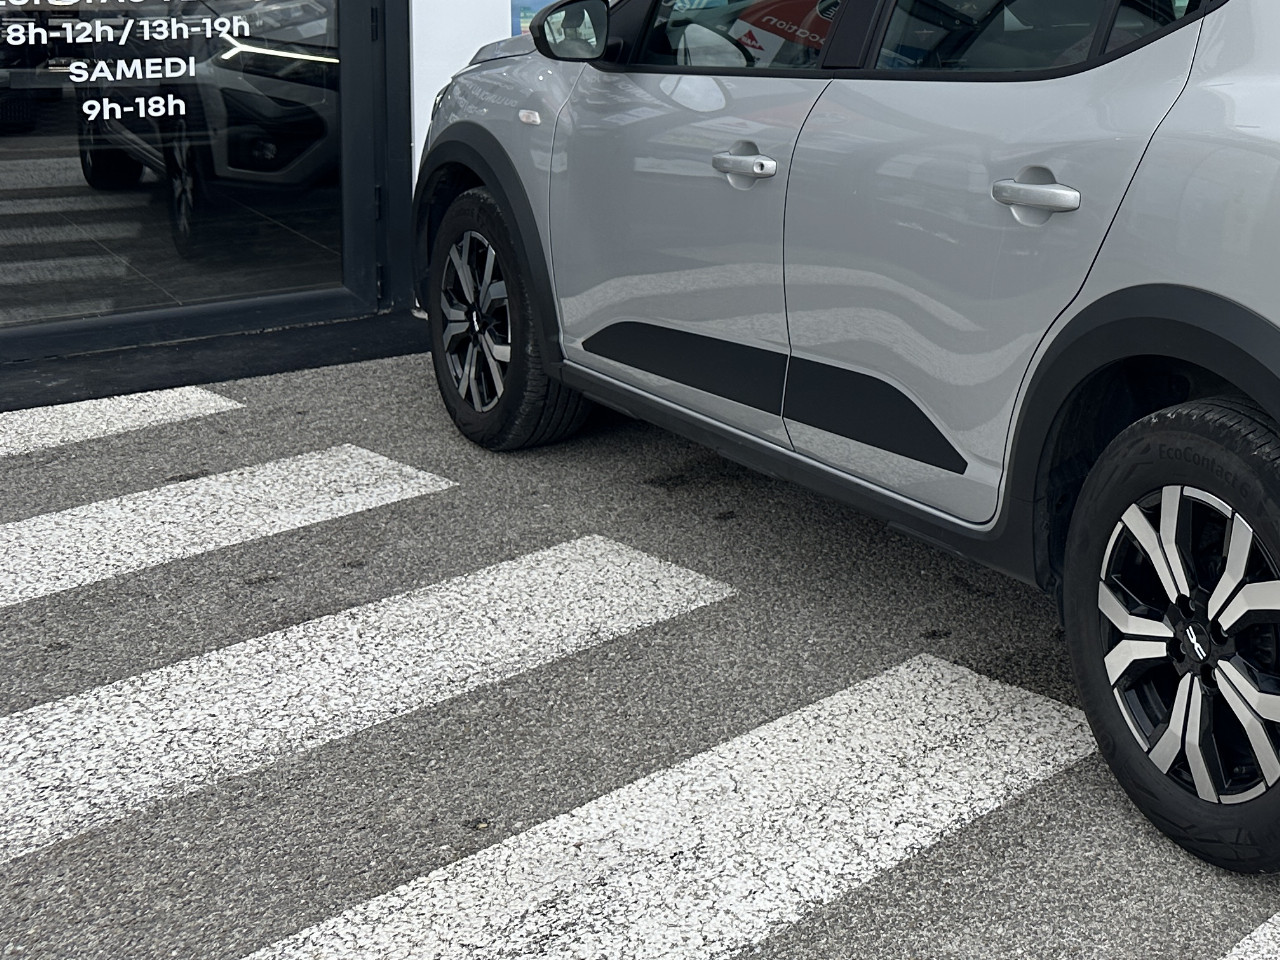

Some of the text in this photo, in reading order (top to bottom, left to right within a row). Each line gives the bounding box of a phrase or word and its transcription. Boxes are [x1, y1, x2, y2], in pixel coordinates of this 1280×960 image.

[6, 16, 250, 46] 8h-12h / 13h-19h
[69, 57, 196, 83] SAMEDI
[82, 94, 186, 121] 9h-18h
